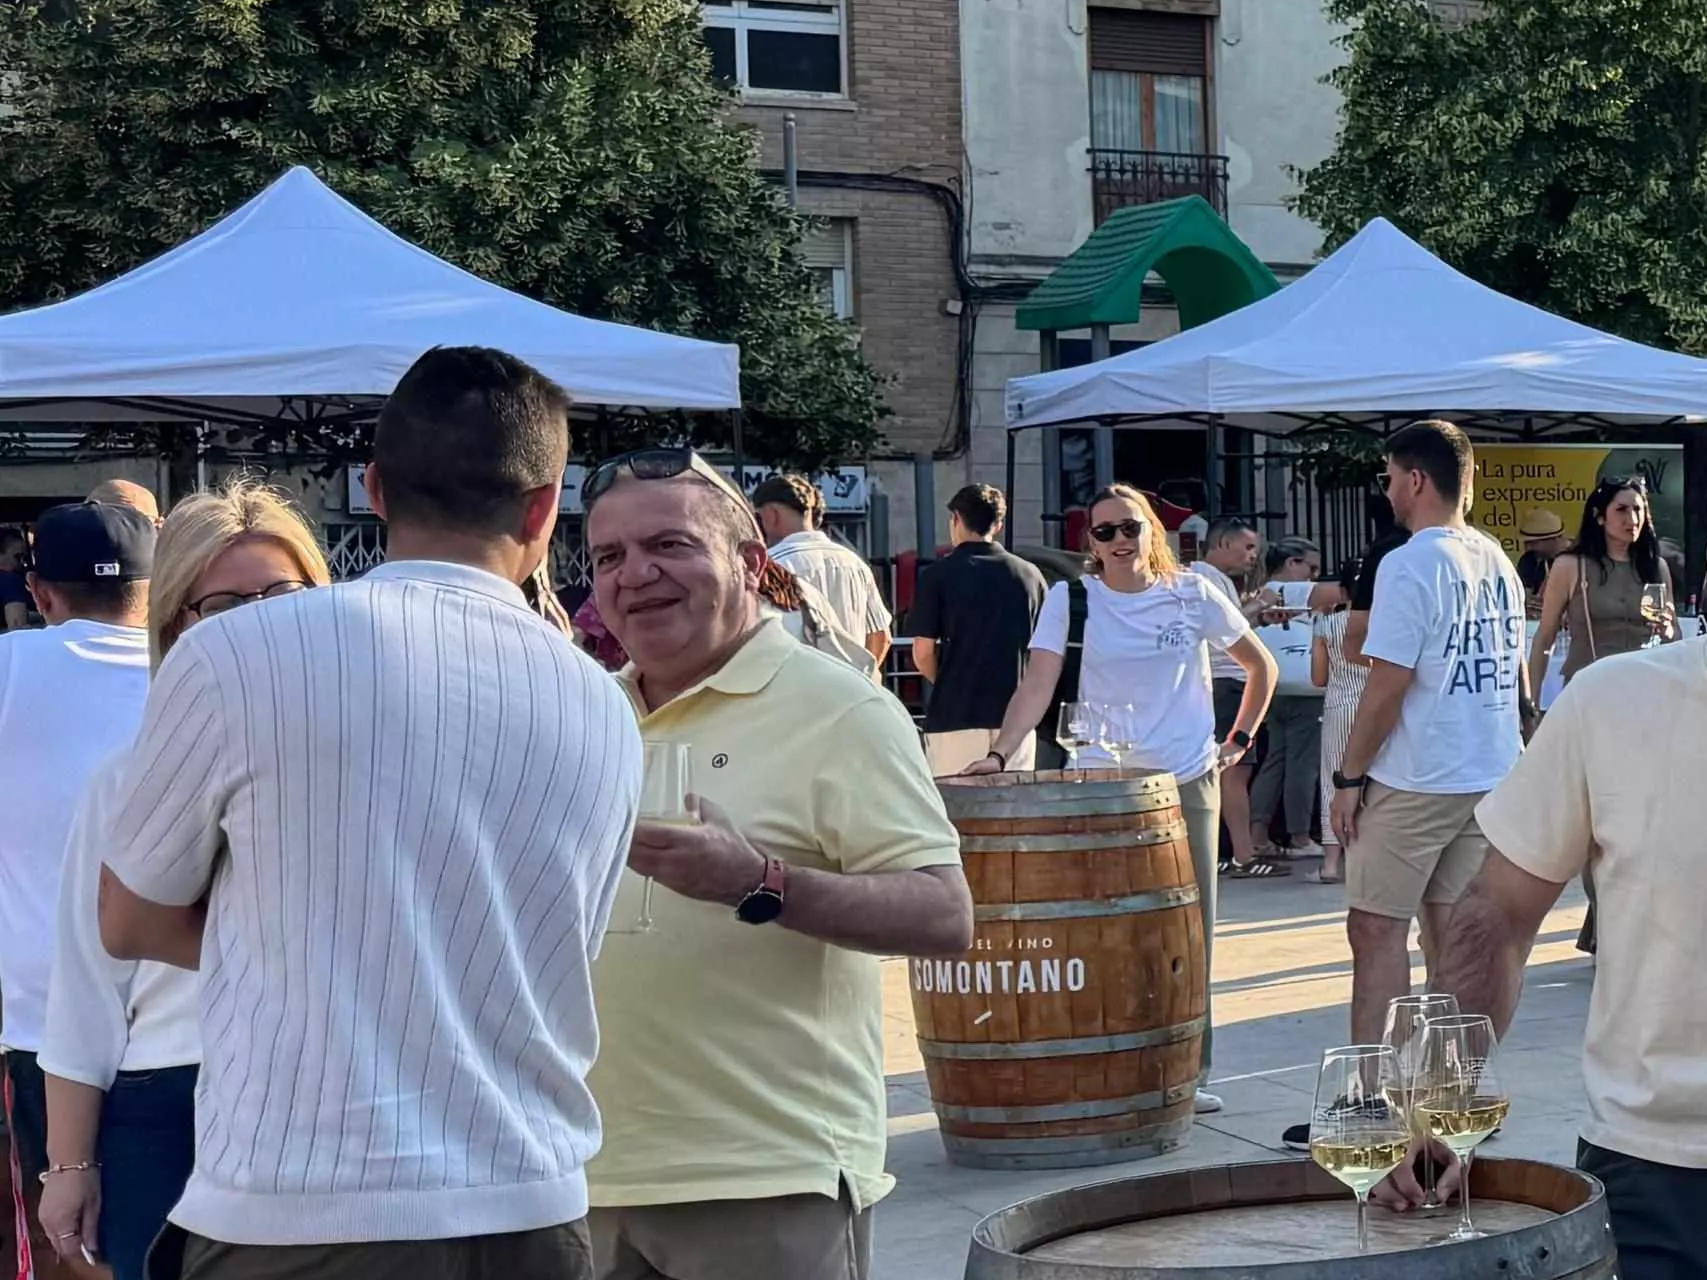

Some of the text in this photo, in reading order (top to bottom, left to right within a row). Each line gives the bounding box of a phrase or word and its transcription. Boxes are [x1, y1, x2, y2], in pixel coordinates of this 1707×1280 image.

[1482, 459, 1556, 482] La pura
[1482, 481, 1587, 504] expresión
[1482, 503, 1517, 527] del
[1448, 656, 1518, 695] ARE
[968, 938, 992, 950] EL
[914, 957, 1085, 994] SOMONTANO
